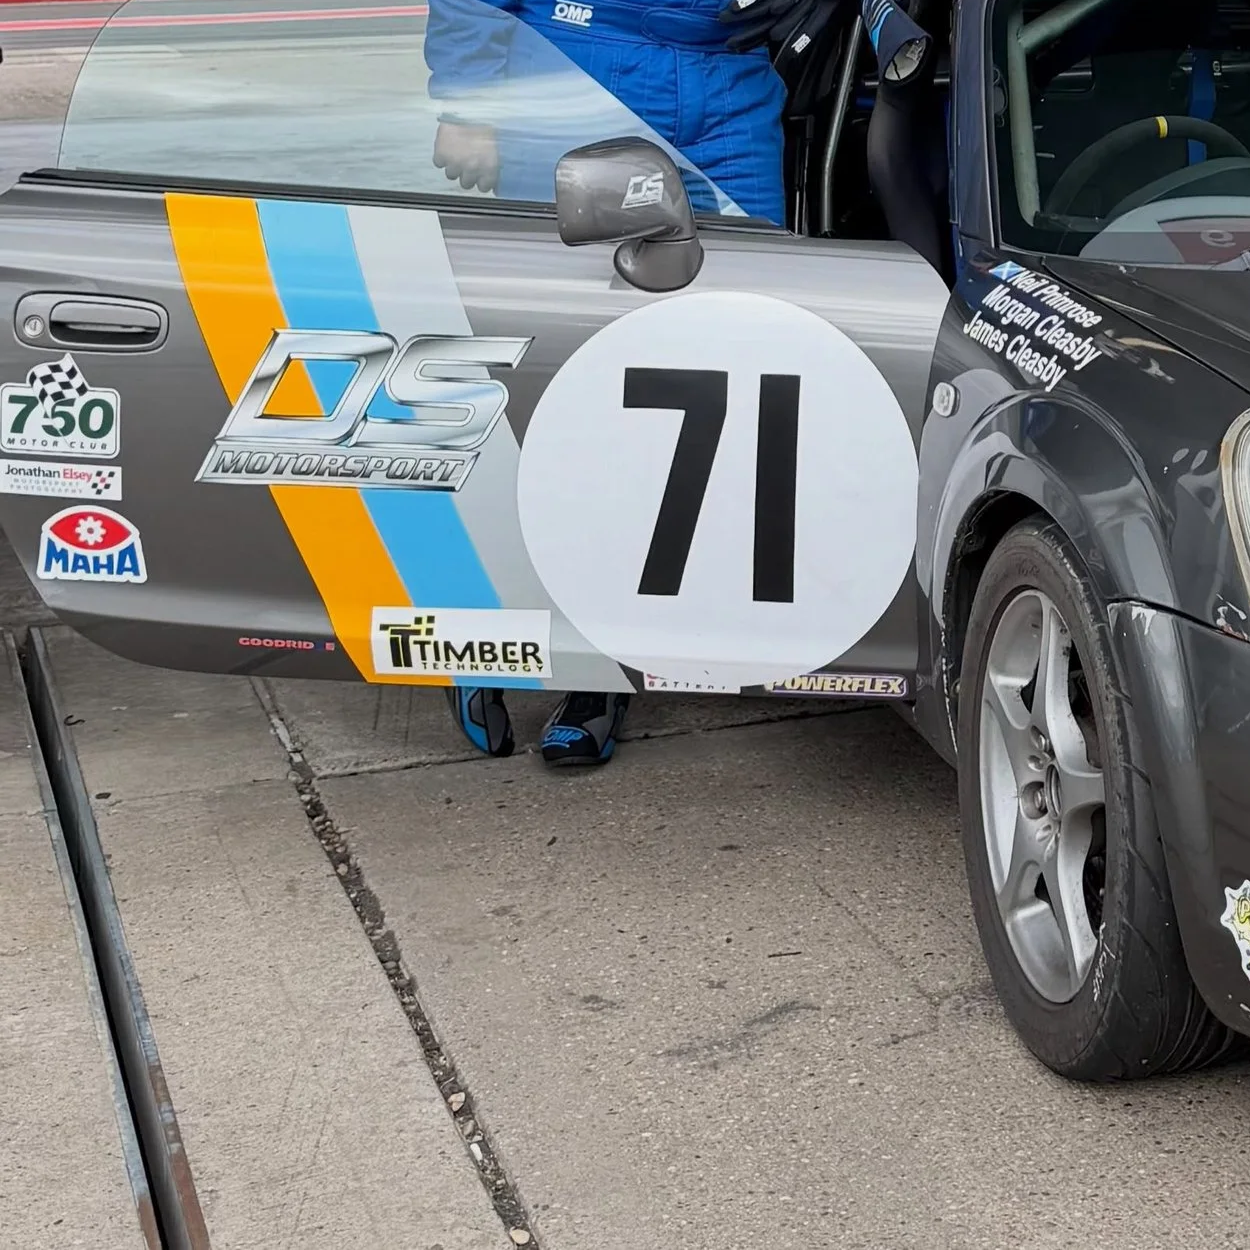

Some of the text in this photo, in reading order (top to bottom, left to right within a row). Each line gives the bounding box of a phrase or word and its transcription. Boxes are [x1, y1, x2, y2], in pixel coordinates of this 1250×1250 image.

[554, 3, 593, 22] OMP
[1007, 269, 1103, 328] Neil Primrose
[981, 283, 1103, 371] Morgan Cleasby
[962, 310, 1068, 393] James Cleasby
[214, 327, 537, 451] DS
[8, 394, 115, 439] 750
[6, 437, 108, 450] MOTOR CLUB
[5, 464, 93, 483] Jonathan Elsey
[212, 450, 466, 483] MOTORSPORT
[622, 366, 802, 604] 71
[43, 537, 141, 577] MAHA
[412, 639, 544, 665] TIMBER
[421, 661, 545, 673] TECHNOLOGY
[765, 673, 906, 695] POWERFLEX
[544, 728, 583, 743] OMP
